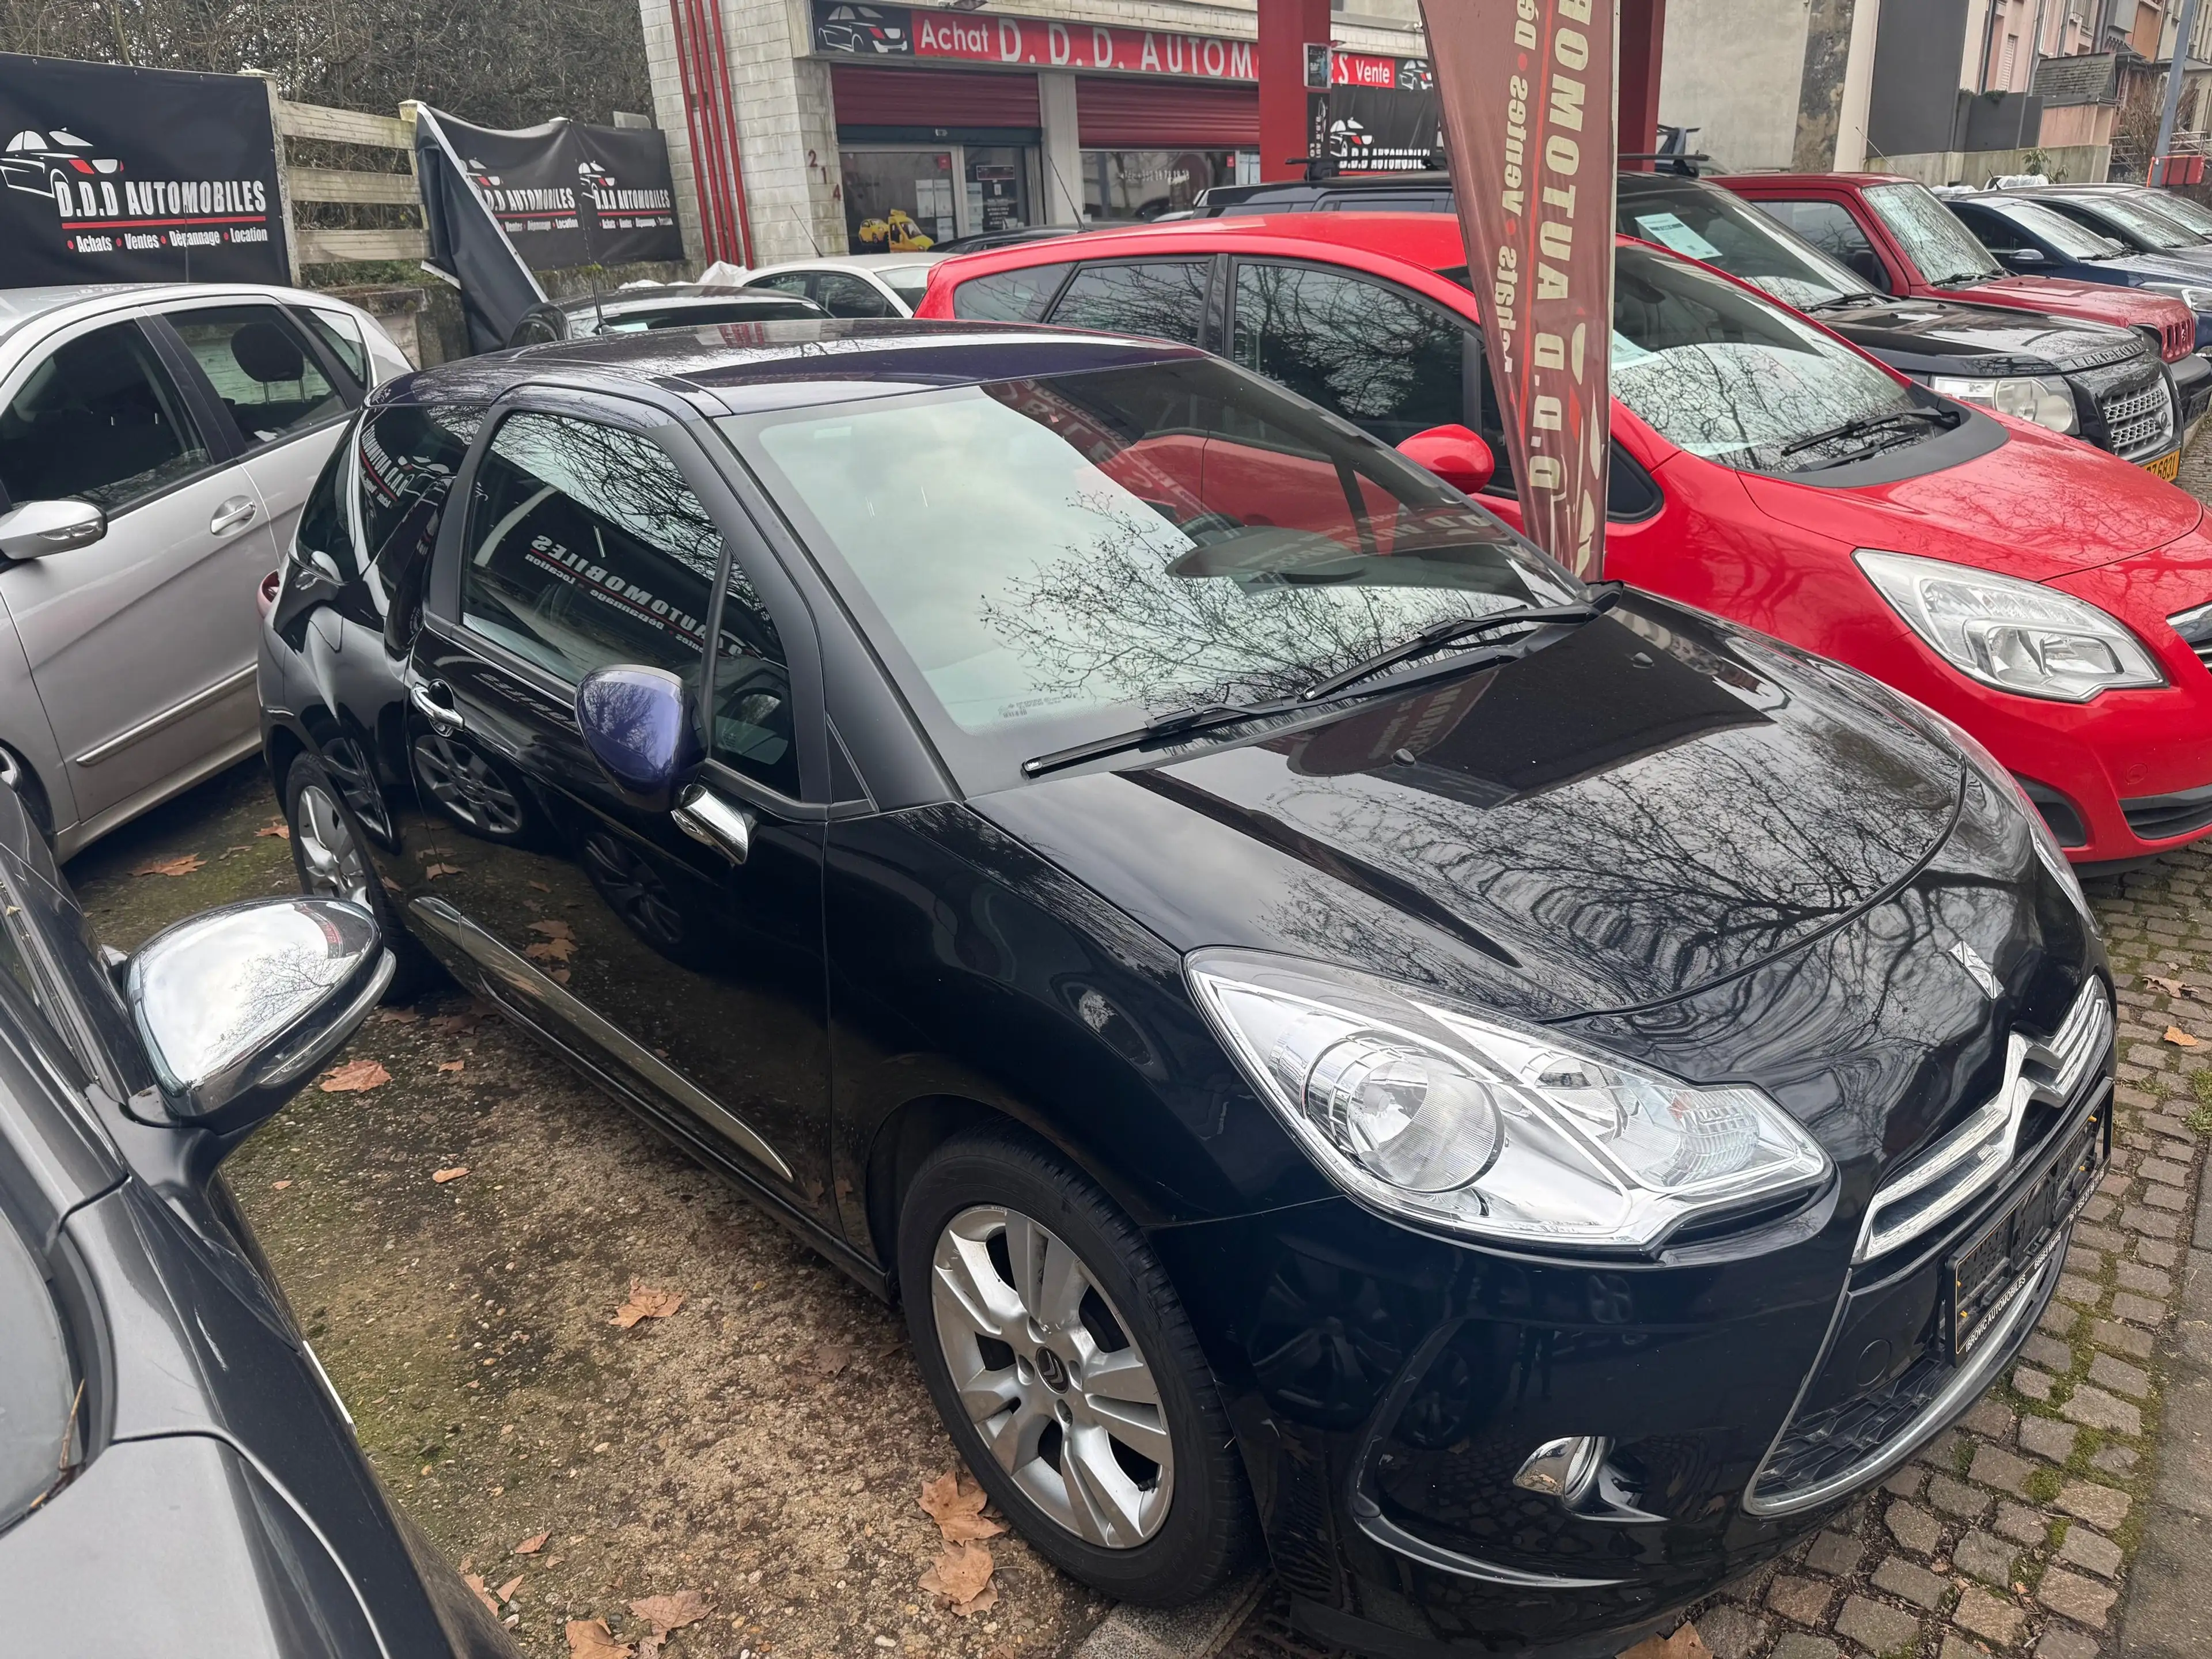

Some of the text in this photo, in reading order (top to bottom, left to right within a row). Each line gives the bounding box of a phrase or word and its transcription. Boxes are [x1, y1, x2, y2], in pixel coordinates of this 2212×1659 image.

[922, 20, 989, 53] Achat
[1355, 59, 1391, 84] Vente
[55, 180, 267, 218] D.D.D AUTOMOBILES
[506, 187, 575, 211] AUTOMOBILES
[617, 189, 671, 210] AUTOMOBILES
[555, 217, 579, 229] Location
[75, 234, 113, 253] Achats
[124, 232, 161, 250] Ventes
[229, 226, 268, 243] Location
[1965, 1318, 1987, 1353] IBROVIC
[1987, 1274, 2026, 1325] AUTOMOBILES
